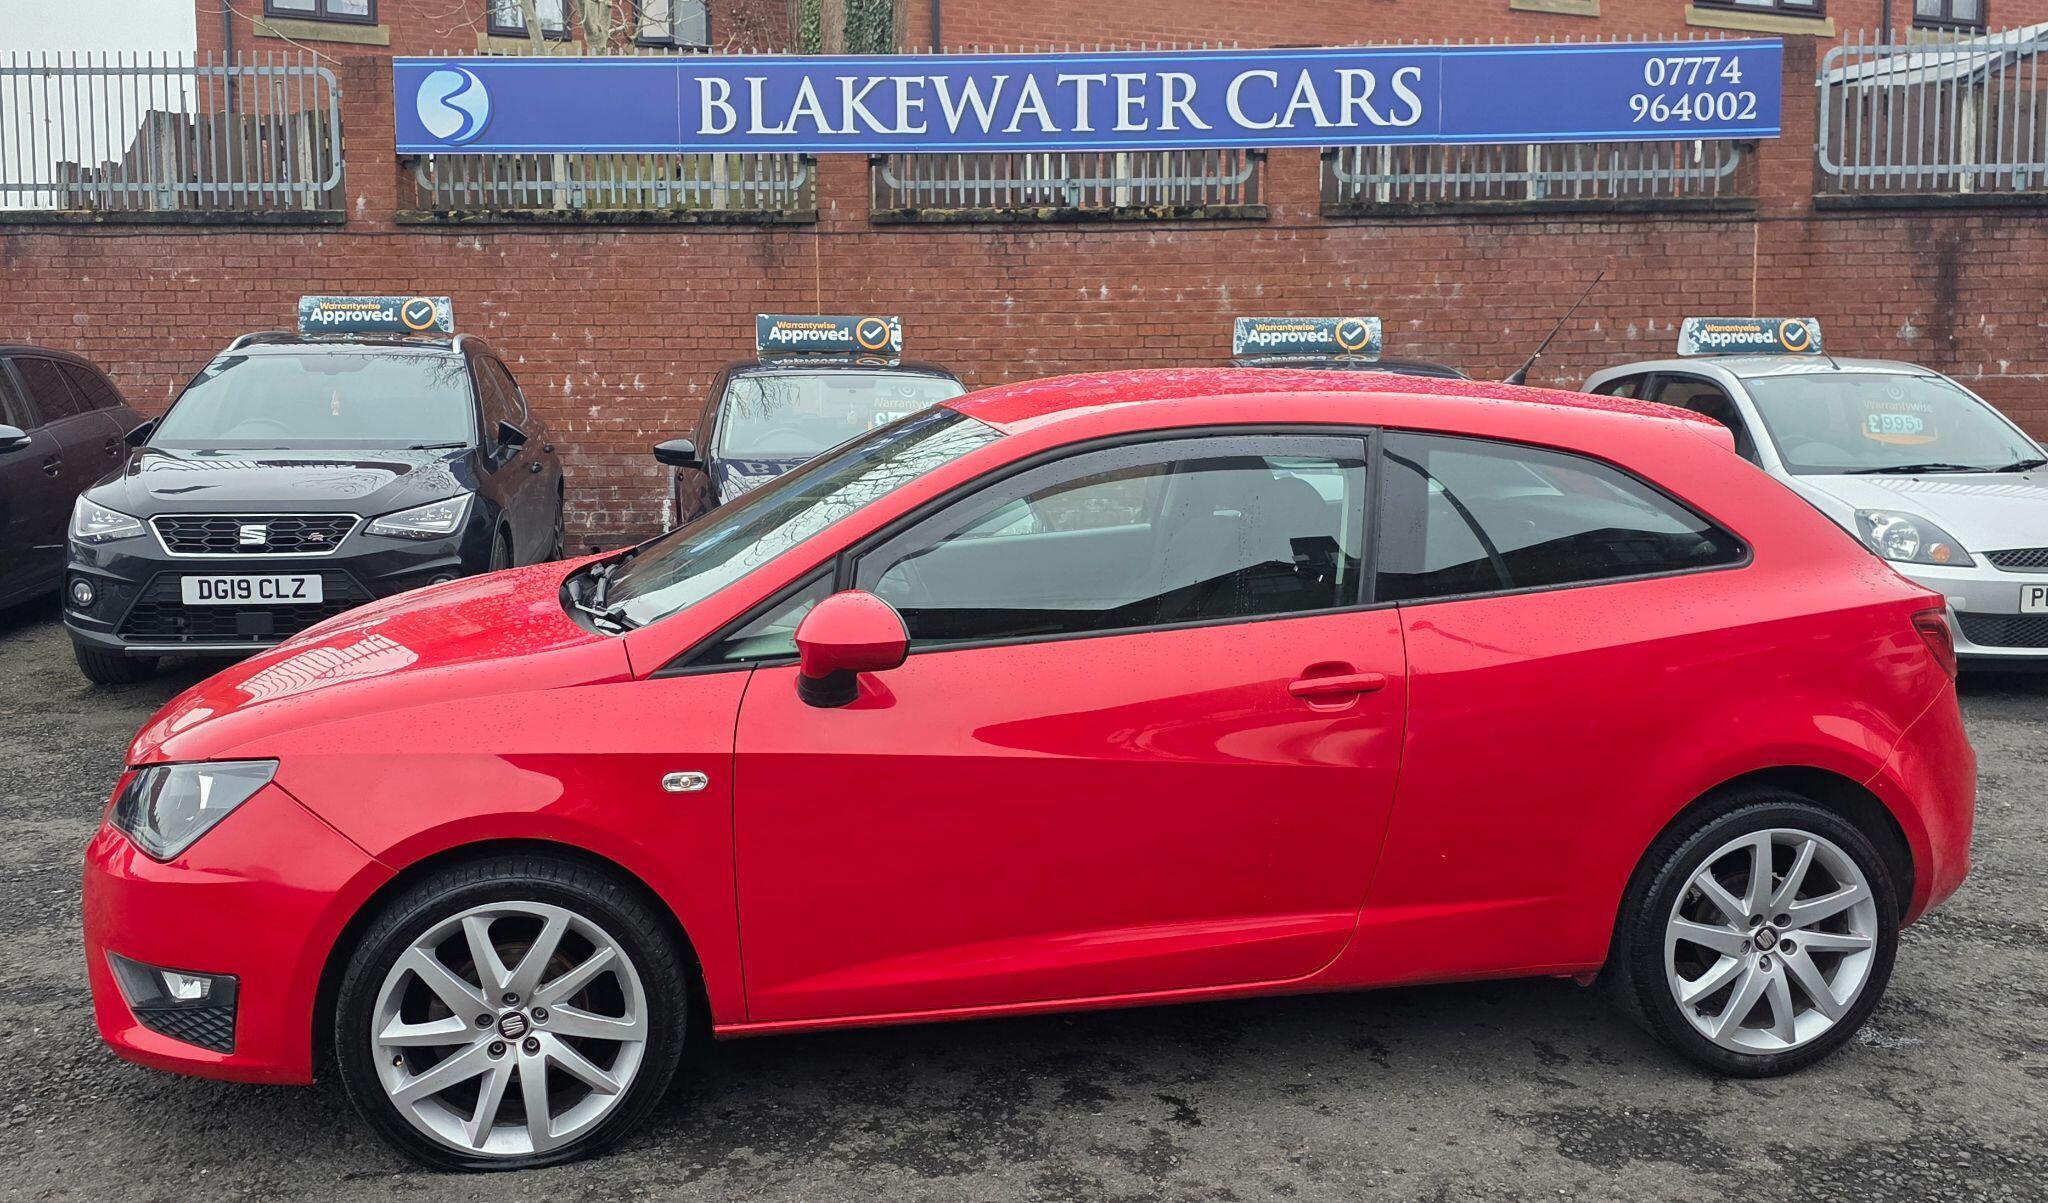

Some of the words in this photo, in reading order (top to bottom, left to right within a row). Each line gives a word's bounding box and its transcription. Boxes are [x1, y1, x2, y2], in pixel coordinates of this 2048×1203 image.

[1644, 55, 1743, 87] 07774
[694, 72, 1213, 135] BLAKEWATER
[1225, 66, 1423, 130] CARS
[1629, 91, 1757, 123] 964002
[319, 302, 381, 310] Warrantywise
[310, 308, 398, 325] Approved.
[776, 321, 836, 329] Warrantywise
[768, 326, 853, 344] Approved.
[1255, 323, 1315, 331] Warrantywise
[1704, 323, 1761, 332] Warrantywise
[1247, 328, 1333, 347] Approved.
[1699, 329, 1778, 347] Approved.
[198, 578, 252, 600] DG19
[259, 577, 307, 599] CLZ
[2031, 587, 2048, 607] P
